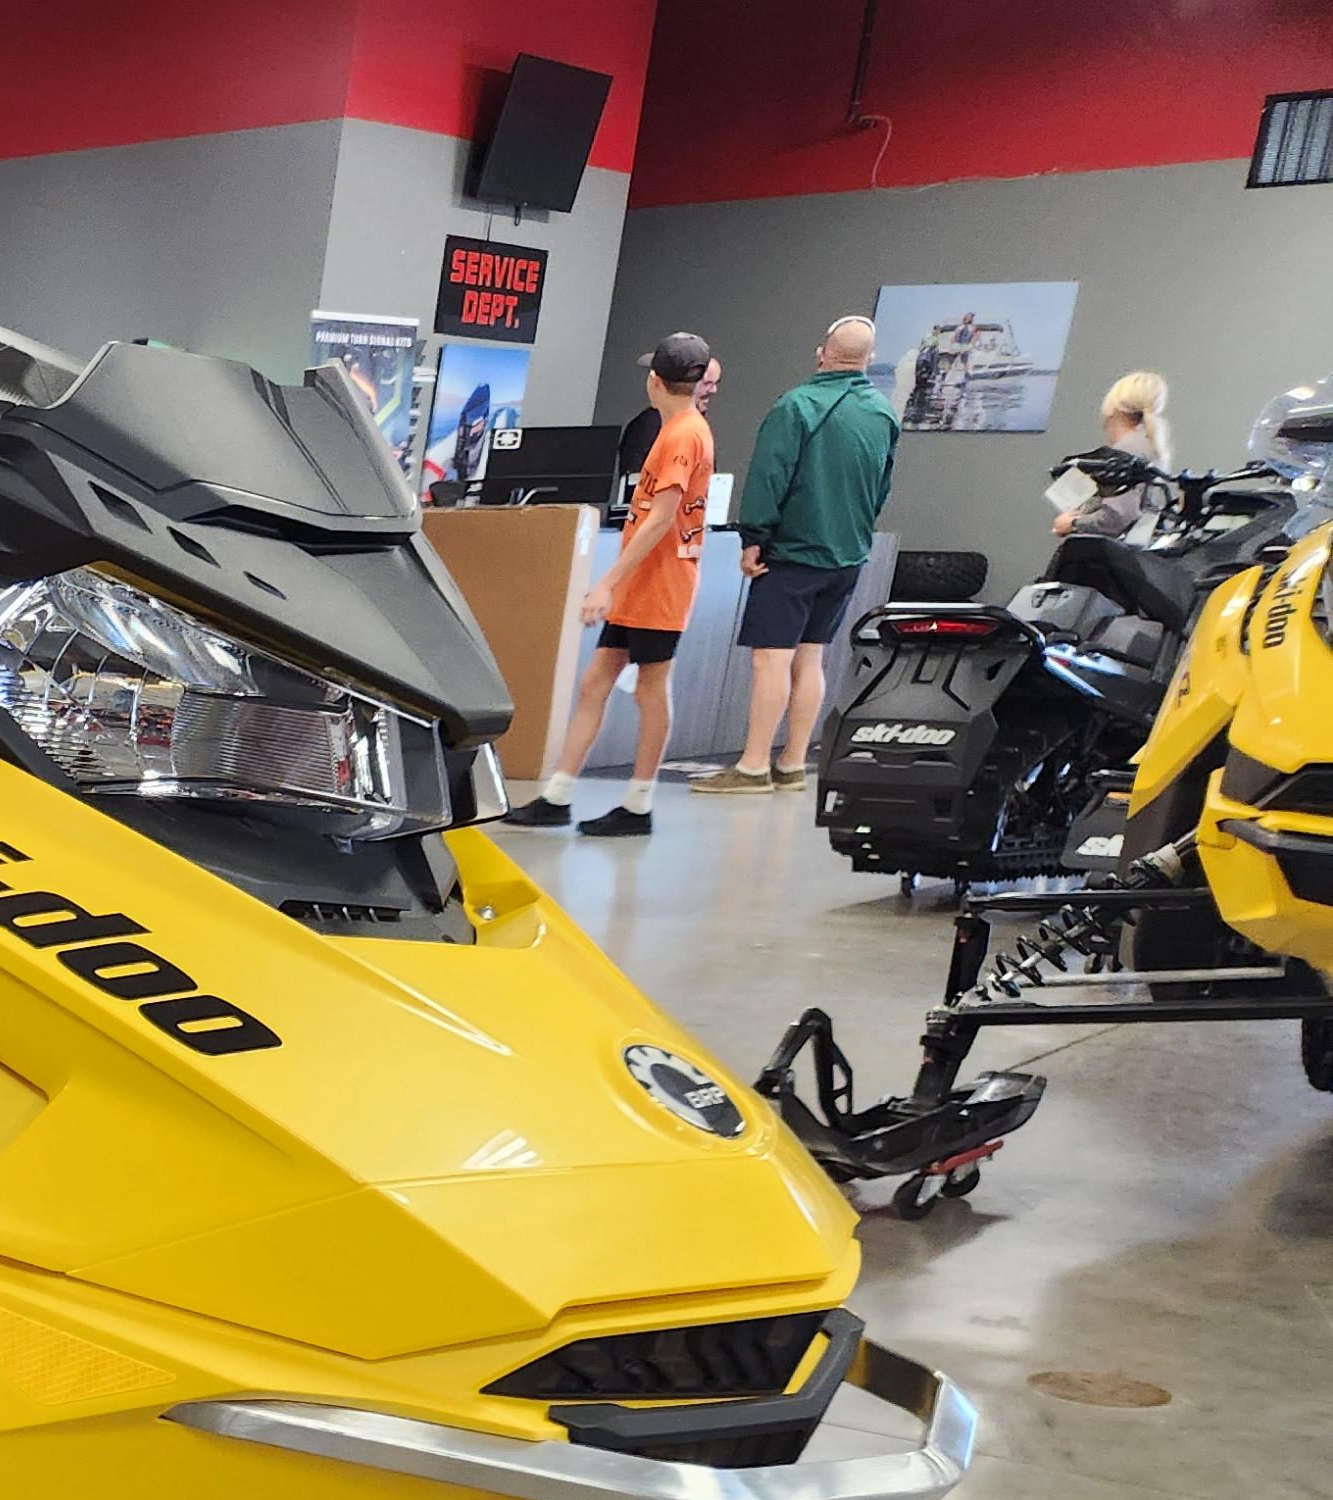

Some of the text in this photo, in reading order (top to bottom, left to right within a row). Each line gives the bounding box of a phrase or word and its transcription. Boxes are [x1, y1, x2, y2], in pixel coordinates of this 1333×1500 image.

[450, 248, 540, 293] SERVICE
[461, 289, 520, 329] DEPT.
[851, 723, 956, 745] ski-doo
[683, 1087, 726, 1109] BRP
